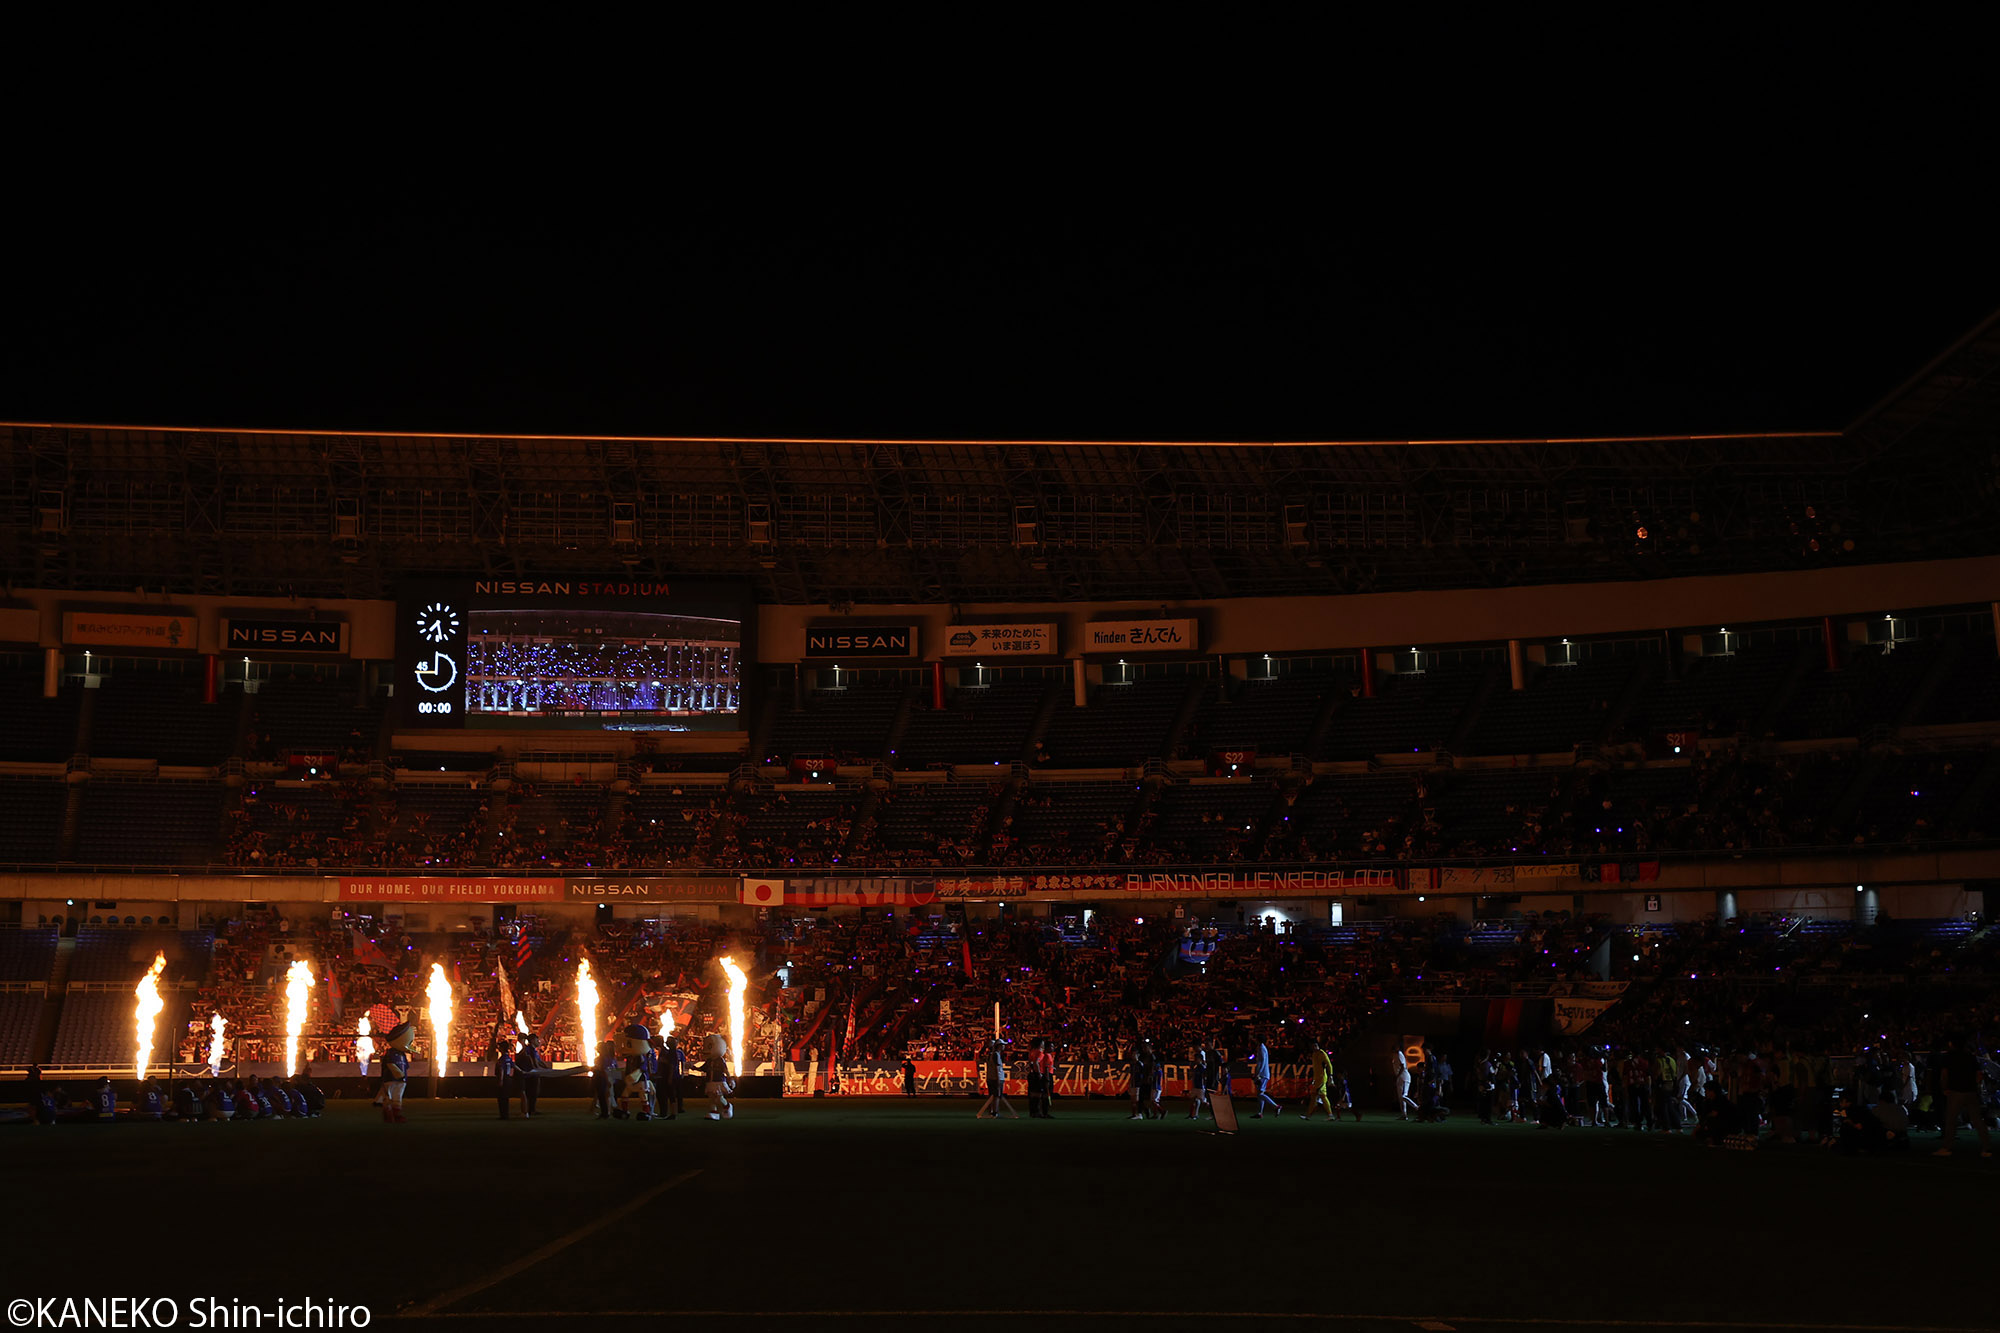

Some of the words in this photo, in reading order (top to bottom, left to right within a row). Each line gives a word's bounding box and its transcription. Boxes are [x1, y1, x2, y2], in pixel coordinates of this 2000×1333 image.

[475, 581, 570, 594] NISSAN
[233, 628, 336, 644] NISSAN
[981, 628, 1047, 639] 未来のために、
[1094, 631, 1126, 643] Kinden
[1130, 627, 1182, 644] きんでん
[810, 635, 905, 649] NISSAN
[992, 640, 1041, 651] いま選ぼう
[416, 661, 428, 671] 45
[418, 702, 452, 714] 00:00
[1666, 732, 1687, 746] S21
[303, 755, 323, 767] S24
[1225, 752, 1244, 765] S22
[805, 759, 825, 771] S23
[350, 884, 372, 894] OUR
[378, 884, 415, 896] HOME,
[422, 884, 444, 895] OUR
[450, 884, 486, 895] FIELD!
[493, 884, 555, 895] YOKOHAMA
[572, 884, 649, 895] NISSAN
[101, 1094, 110, 1107] 8
